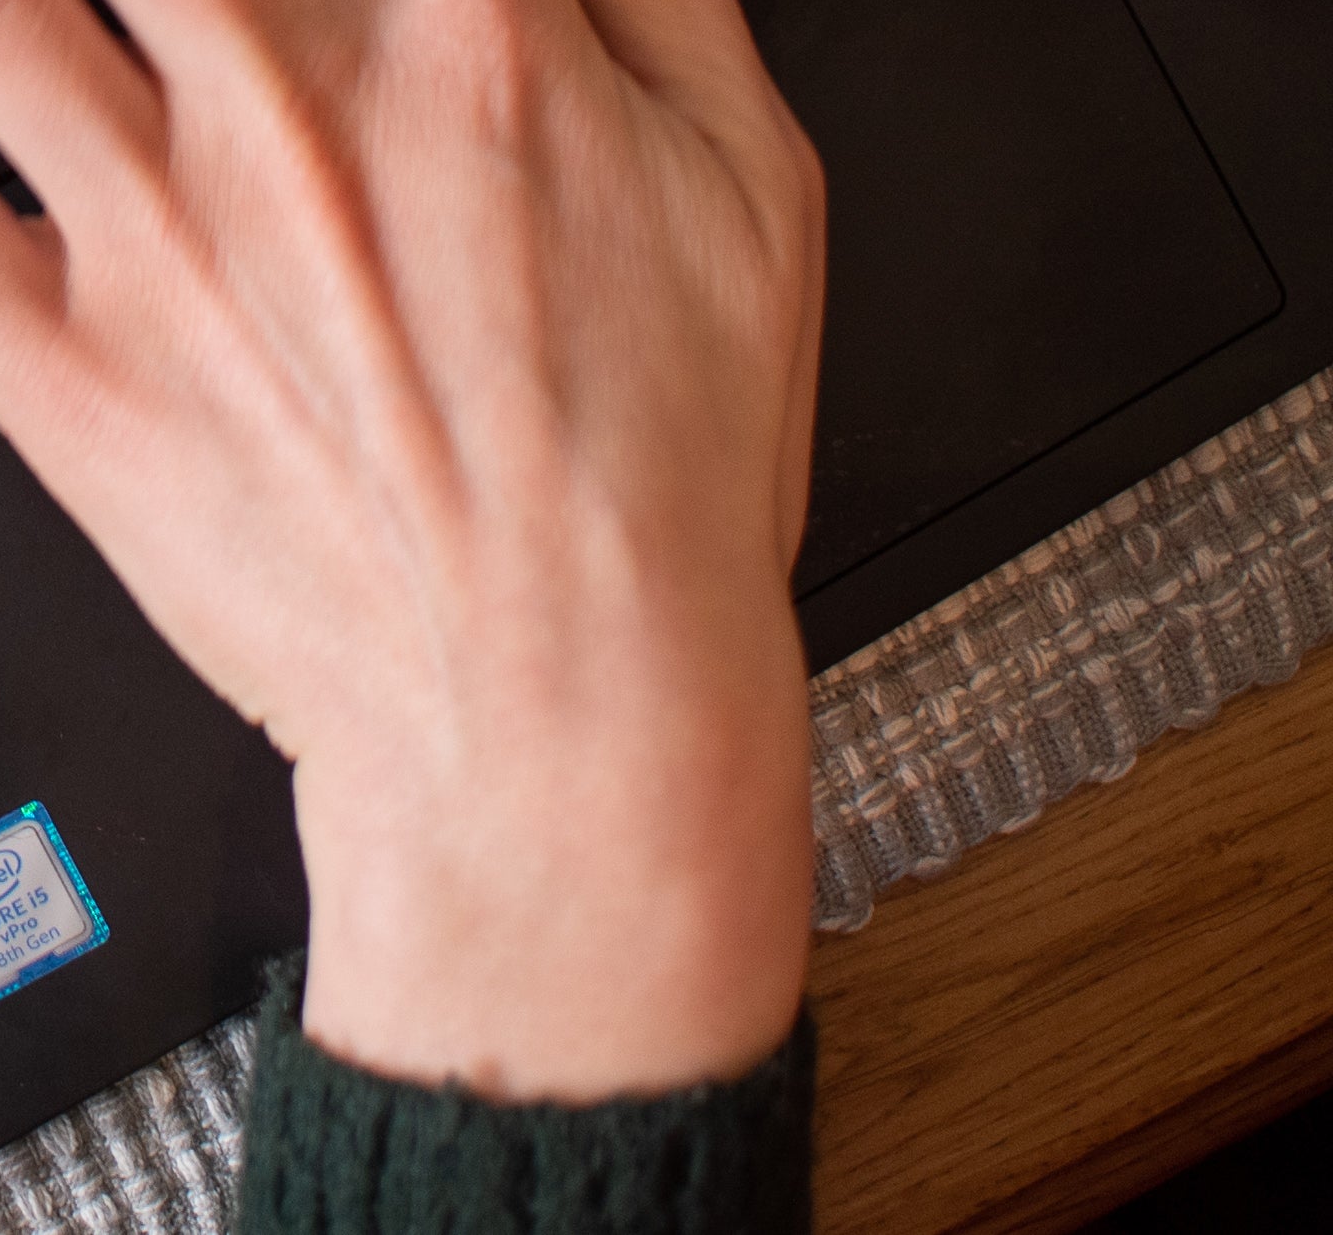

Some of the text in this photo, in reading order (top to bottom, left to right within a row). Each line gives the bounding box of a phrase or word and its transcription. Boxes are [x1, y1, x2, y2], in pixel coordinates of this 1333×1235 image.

[26, 886, 49, 910] i5
[0, 916, 38, 944] vPro
[26, 925, 61, 951] Gen
